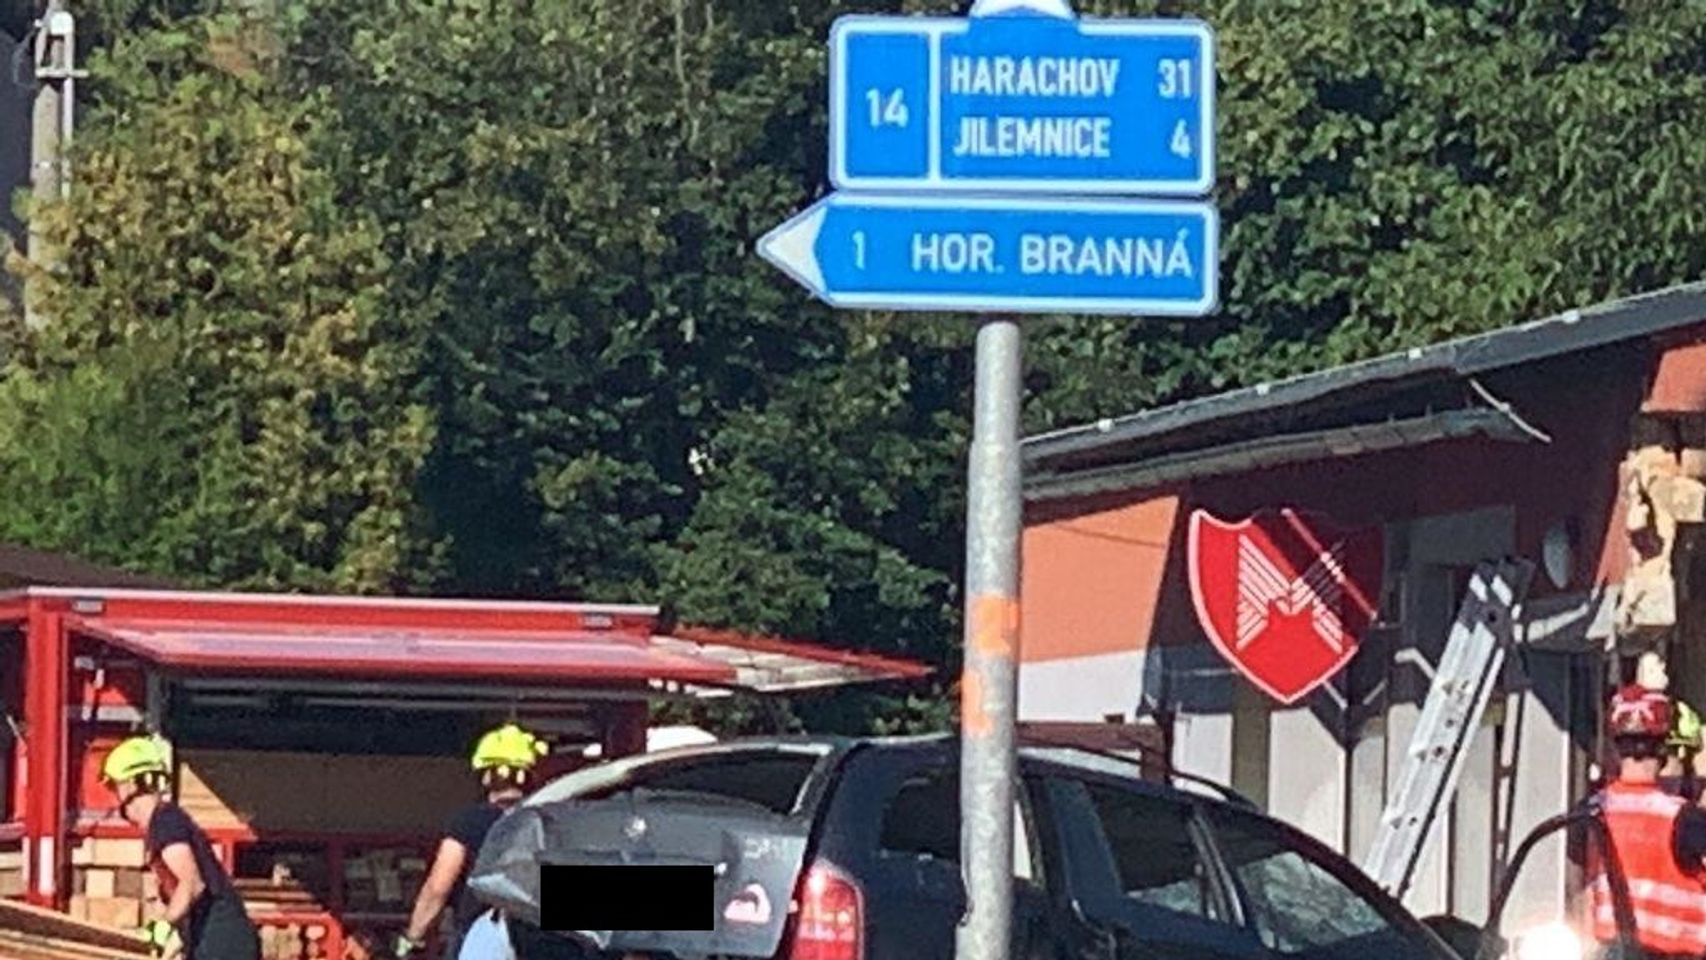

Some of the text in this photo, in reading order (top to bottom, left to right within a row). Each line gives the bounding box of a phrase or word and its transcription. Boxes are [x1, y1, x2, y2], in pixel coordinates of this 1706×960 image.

[949, 56, 1193, 99] HARACHOV 31
[865, 88, 909, 128] 14
[952, 116, 1193, 158] JILEMNICE 4
[851, 227, 1194, 279] 1 HOR. BRANNÁ
